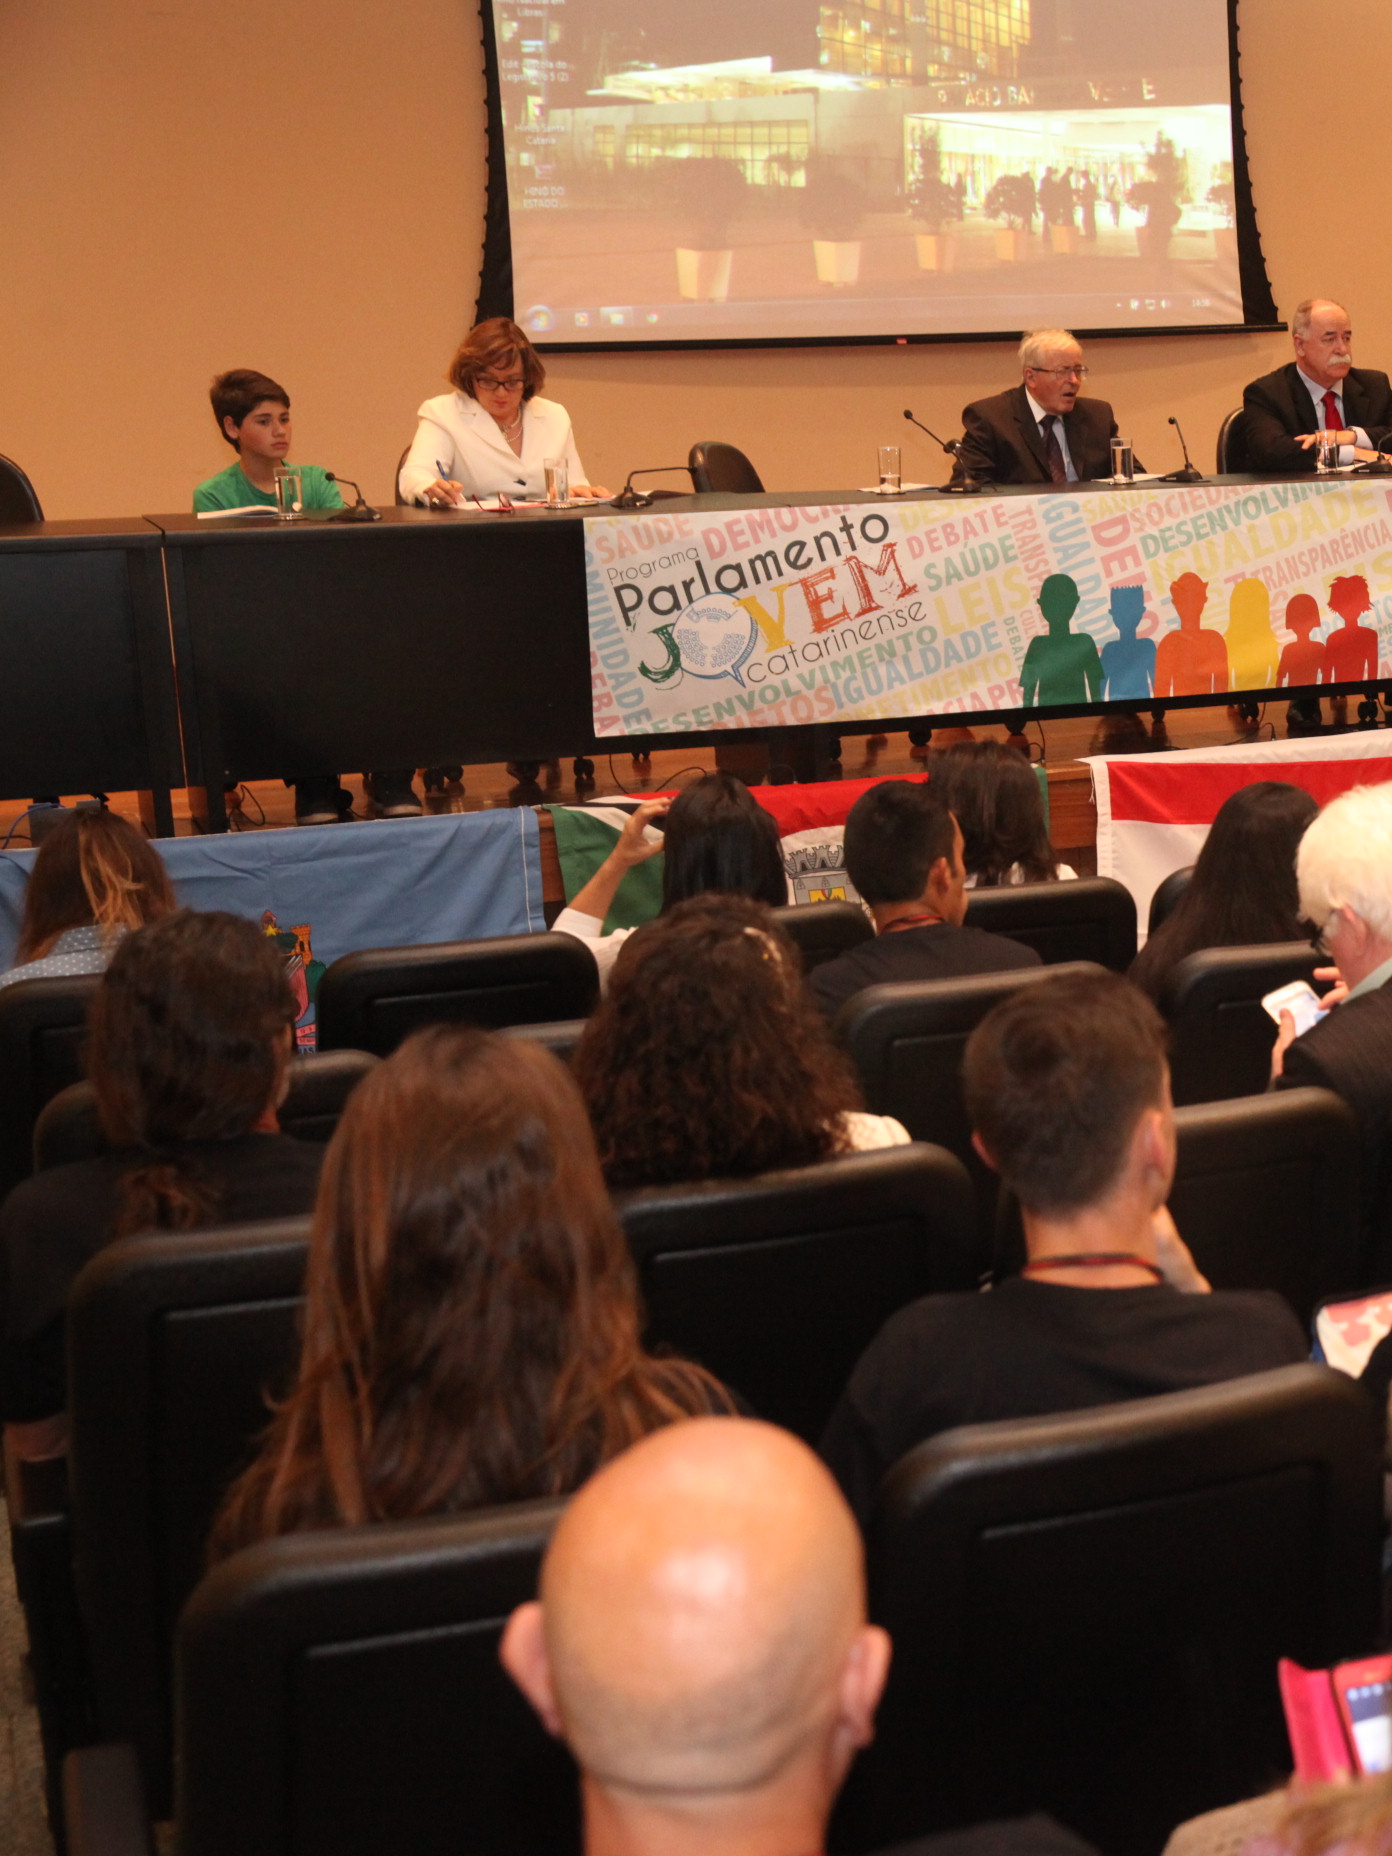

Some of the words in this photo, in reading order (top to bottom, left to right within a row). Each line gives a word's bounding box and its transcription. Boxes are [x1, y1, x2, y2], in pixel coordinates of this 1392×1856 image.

[606, 546, 700, 586] Programa
[613, 513, 889, 627] Parlamento
[906, 503, 1010, 561] DEBATE
[923, 534, 1019, 593] SAÚDE
[1149, 479, 1379, 596] IGUALDADE
[638, 541, 919, 691] JOVEM
[747, 600, 927, 683] catarinense
[931, 565, 1032, 638] LEIS
[829, 621, 1003, 710] IGUALDADE
